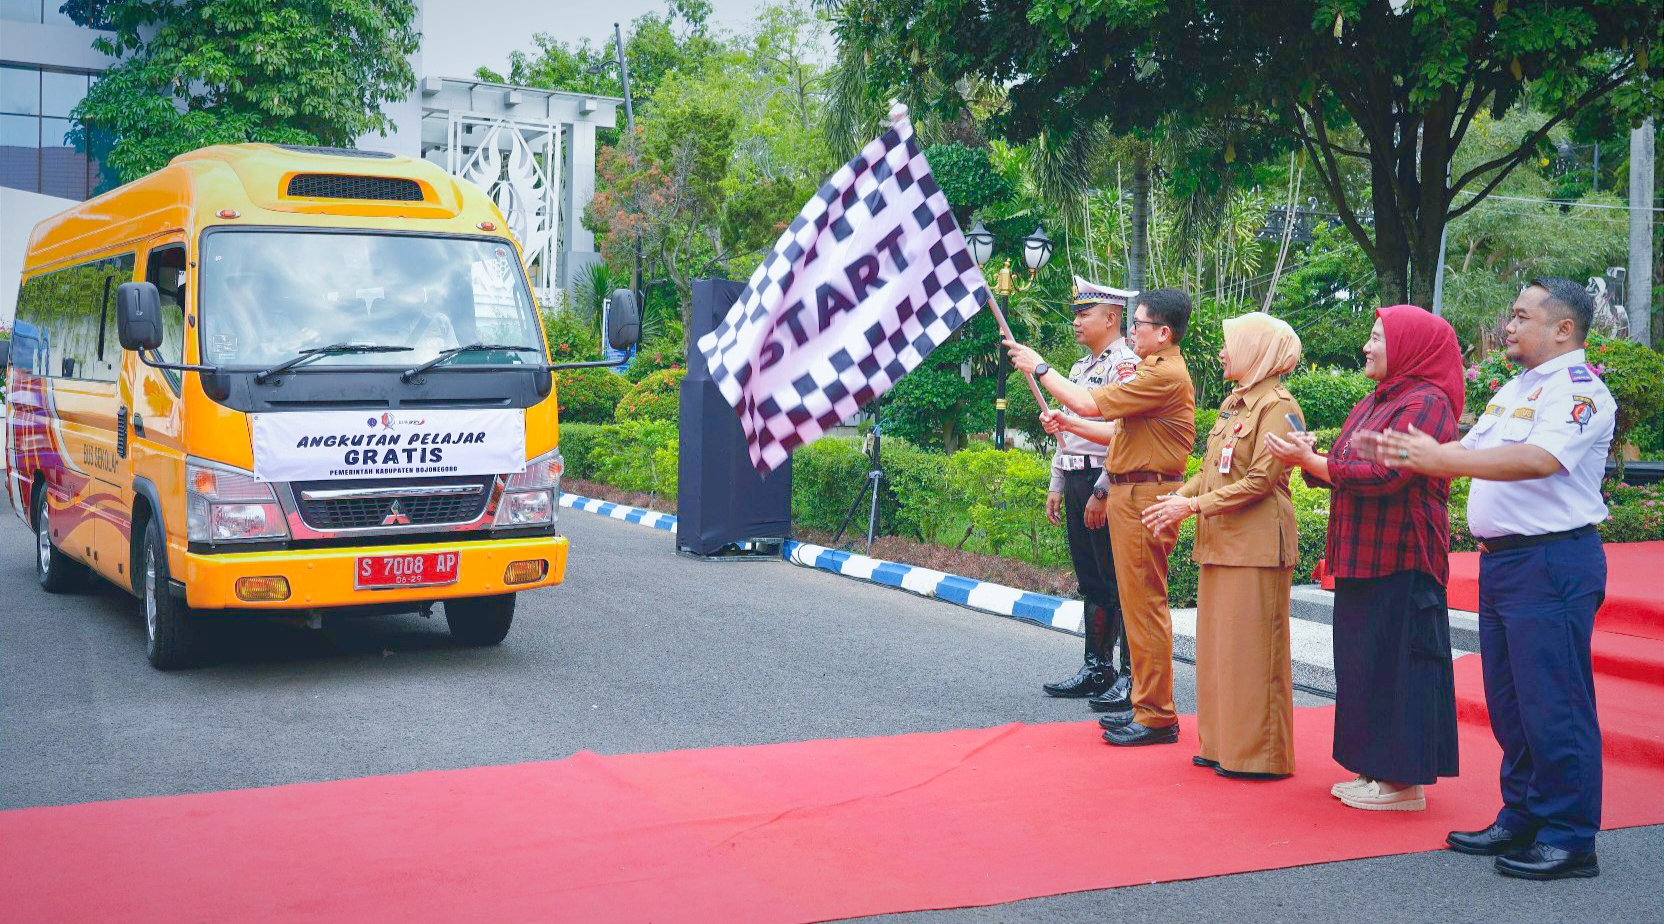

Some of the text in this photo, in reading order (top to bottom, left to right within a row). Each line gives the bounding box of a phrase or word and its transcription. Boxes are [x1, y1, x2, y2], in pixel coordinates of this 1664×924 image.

[759, 223, 909, 373] START
[297, 431, 486, 449] ANGKUTAN PELAJAR
[83, 443, 94, 466] BUS
[344, 447, 443, 465] GRATIS
[329, 466, 458, 476] PEMERINTAH KABUPATEN BOJONEGORO
[361, 554, 456, 577] S 7008 AP
[395, 575, 422, 584] 06-29
